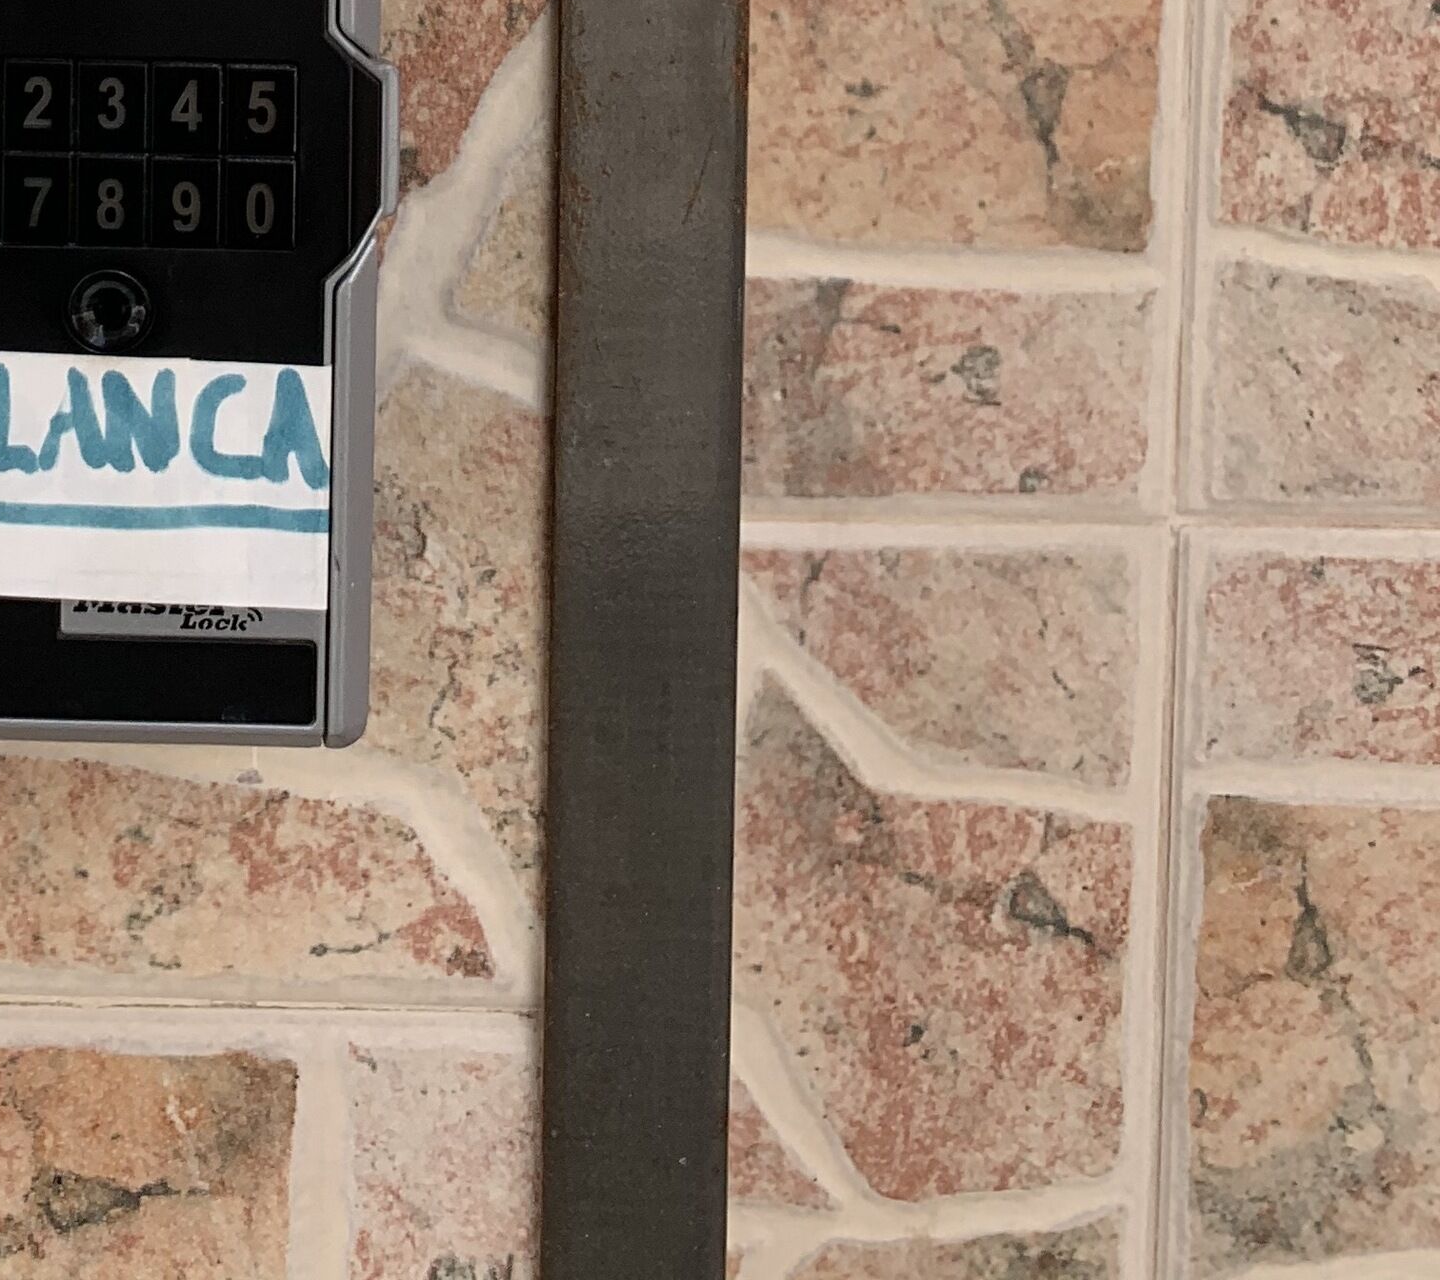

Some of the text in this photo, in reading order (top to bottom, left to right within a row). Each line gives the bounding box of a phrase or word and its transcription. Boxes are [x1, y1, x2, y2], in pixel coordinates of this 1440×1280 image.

[23, 76, 52, 129] 2
[97, 77, 126, 130] 3
[171, 79, 203, 132] 4
[248, 81, 277, 134] 5
[23, 177, 52, 227] 7
[97, 178, 125, 230] 8
[172, 181, 201, 233] 9
[246, 182, 275, 234] 0
[180, 613, 247, 631] Lock
